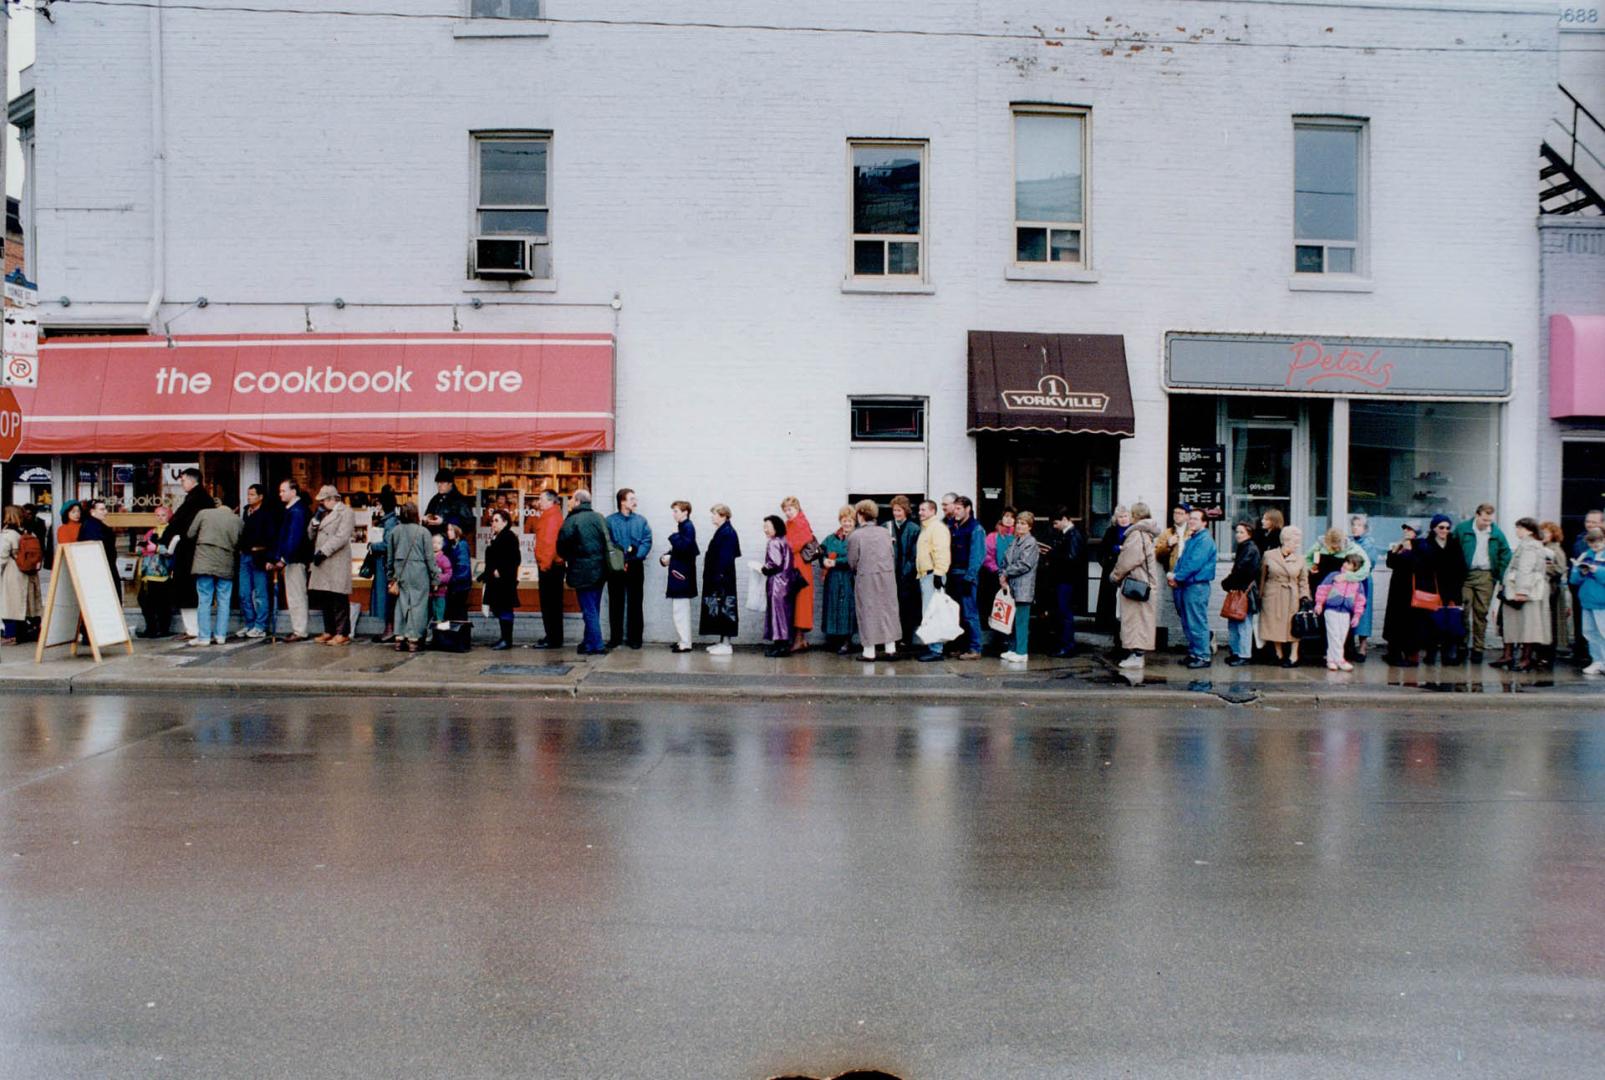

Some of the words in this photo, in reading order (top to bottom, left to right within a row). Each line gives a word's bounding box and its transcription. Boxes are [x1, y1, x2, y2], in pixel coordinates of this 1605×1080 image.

[1285, 341, 1394, 388] Petals
[155, 367, 212, 394] the
[233, 365, 413, 394] cookbook
[435, 364, 523, 393] store
[1048, 379, 1060, 396] 1
[1010, 395, 1103, 408] YORKVILLE
[0, 410, 20, 438] OP
